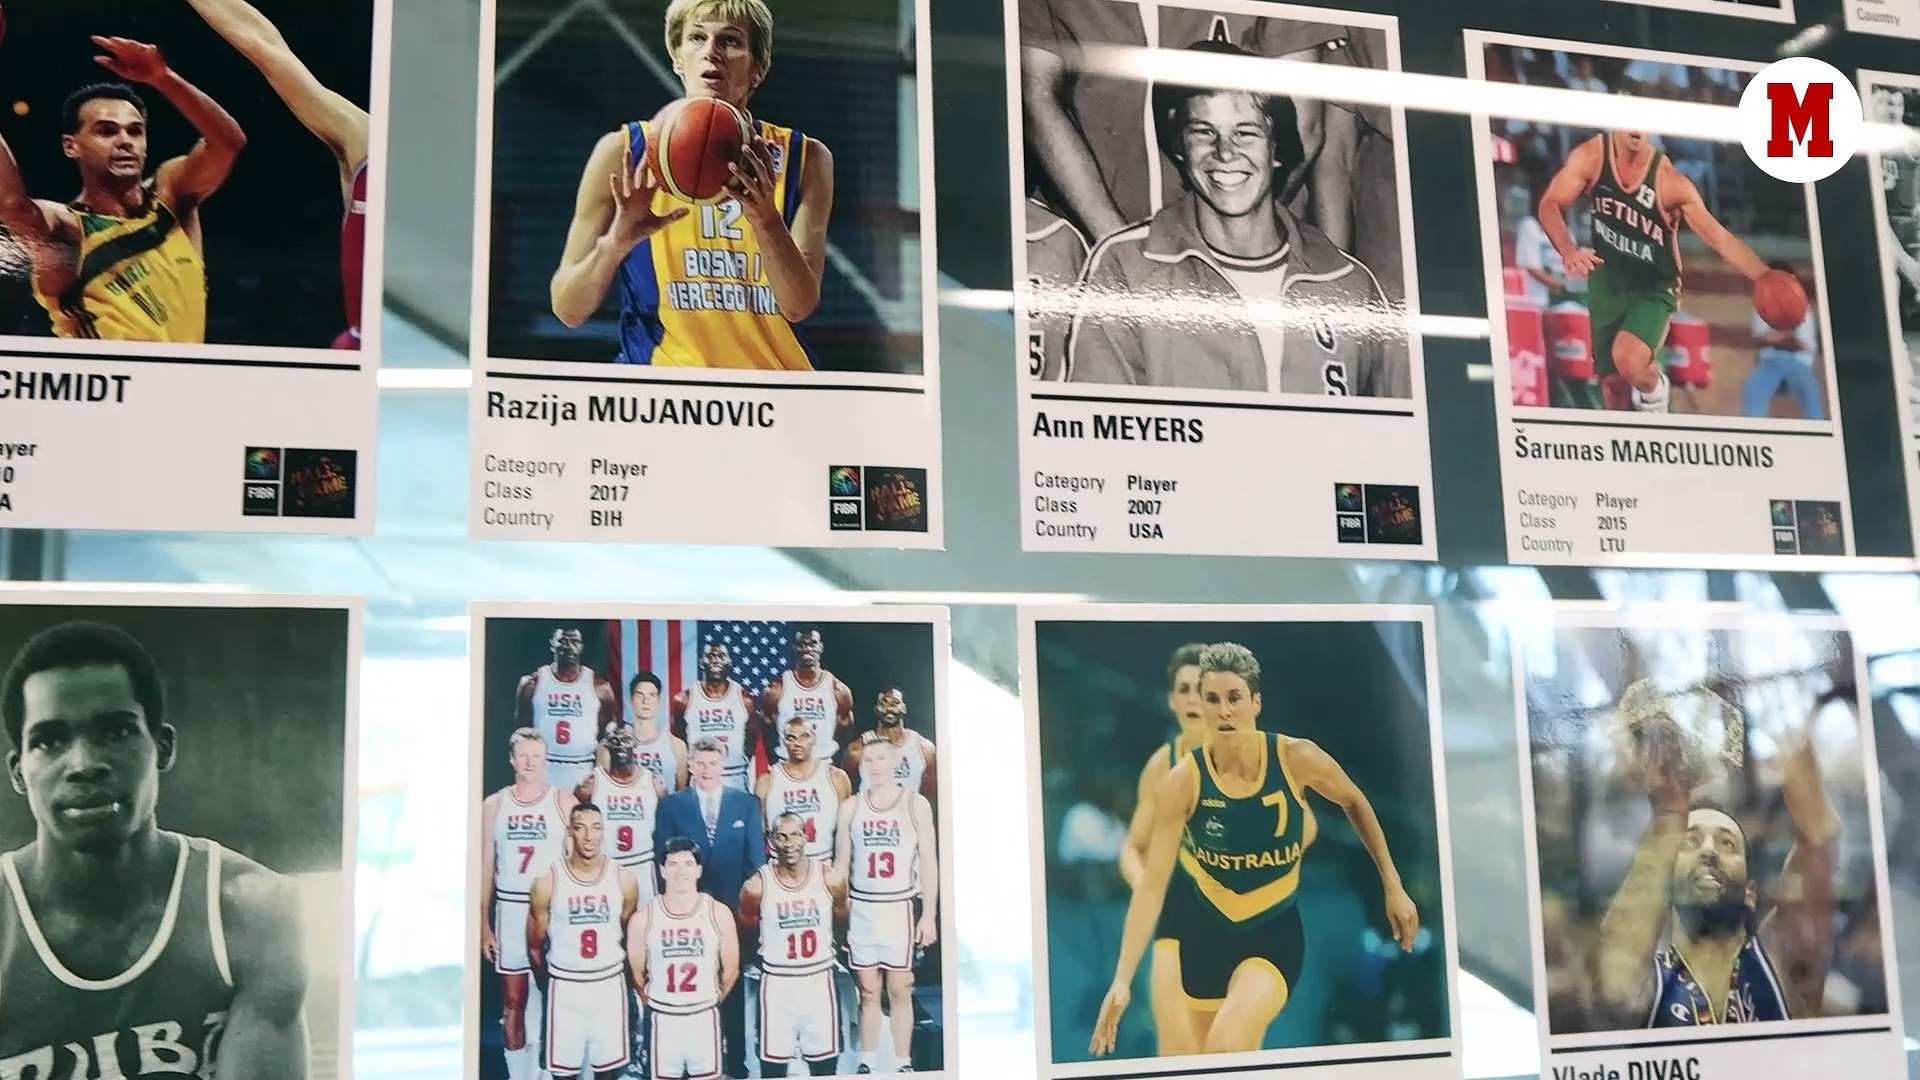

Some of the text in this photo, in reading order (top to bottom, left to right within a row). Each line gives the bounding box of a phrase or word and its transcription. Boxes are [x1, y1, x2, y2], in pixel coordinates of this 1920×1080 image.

[701, 200, 743, 240] 12
[1591, 197, 1665, 247] IETUVA
[684, 248, 748, 281] BOSNA
[0, 369, 131, 403] CHMIDT
[487, 391, 775, 428] Razija MUJANOVIC
[1033, 411, 1204, 443] Ann MEYERS
[1515, 429, 1774, 468] Šarunas MARCIULIONIS
[485, 454, 648, 479] Category Player
[485, 481, 629, 502] Class 2017
[1034, 471, 1178, 494] Category Player
[1035, 495, 1162, 516] Class 2007
[1518, 490, 1638, 510] Category Player
[484, 507, 623, 528] Country BIH
[1520, 513, 1628, 531] Class 2015
[1035, 519, 1164, 541] Country USA
[1521, 535, 1625, 553] Country LTU
[548, 693, 583, 709] USA
[699, 709, 735, 723] USA
[555, 720, 571, 745] 6
[607, 795, 645, 812] USA
[783, 788, 820, 805] USA
[507, 814, 547, 832] USA
[1261, 790, 1289, 838] 7
[617, 825, 633, 852] 9
[862, 819, 900, 837] USA
[518, 845, 535, 874] 7
[867, 851, 895, 879] 13
[1196, 842, 1301, 871] AUSTRALIA
[567, 894, 610, 915] USA
[776, 898, 821, 920] USA
[580, 928, 598, 959] 8
[661, 928, 705, 947] USA
[786, 928, 818, 960] 10
[666, 961, 698, 994] 12
[1628, 1057, 1700, 1080] DIVAC
